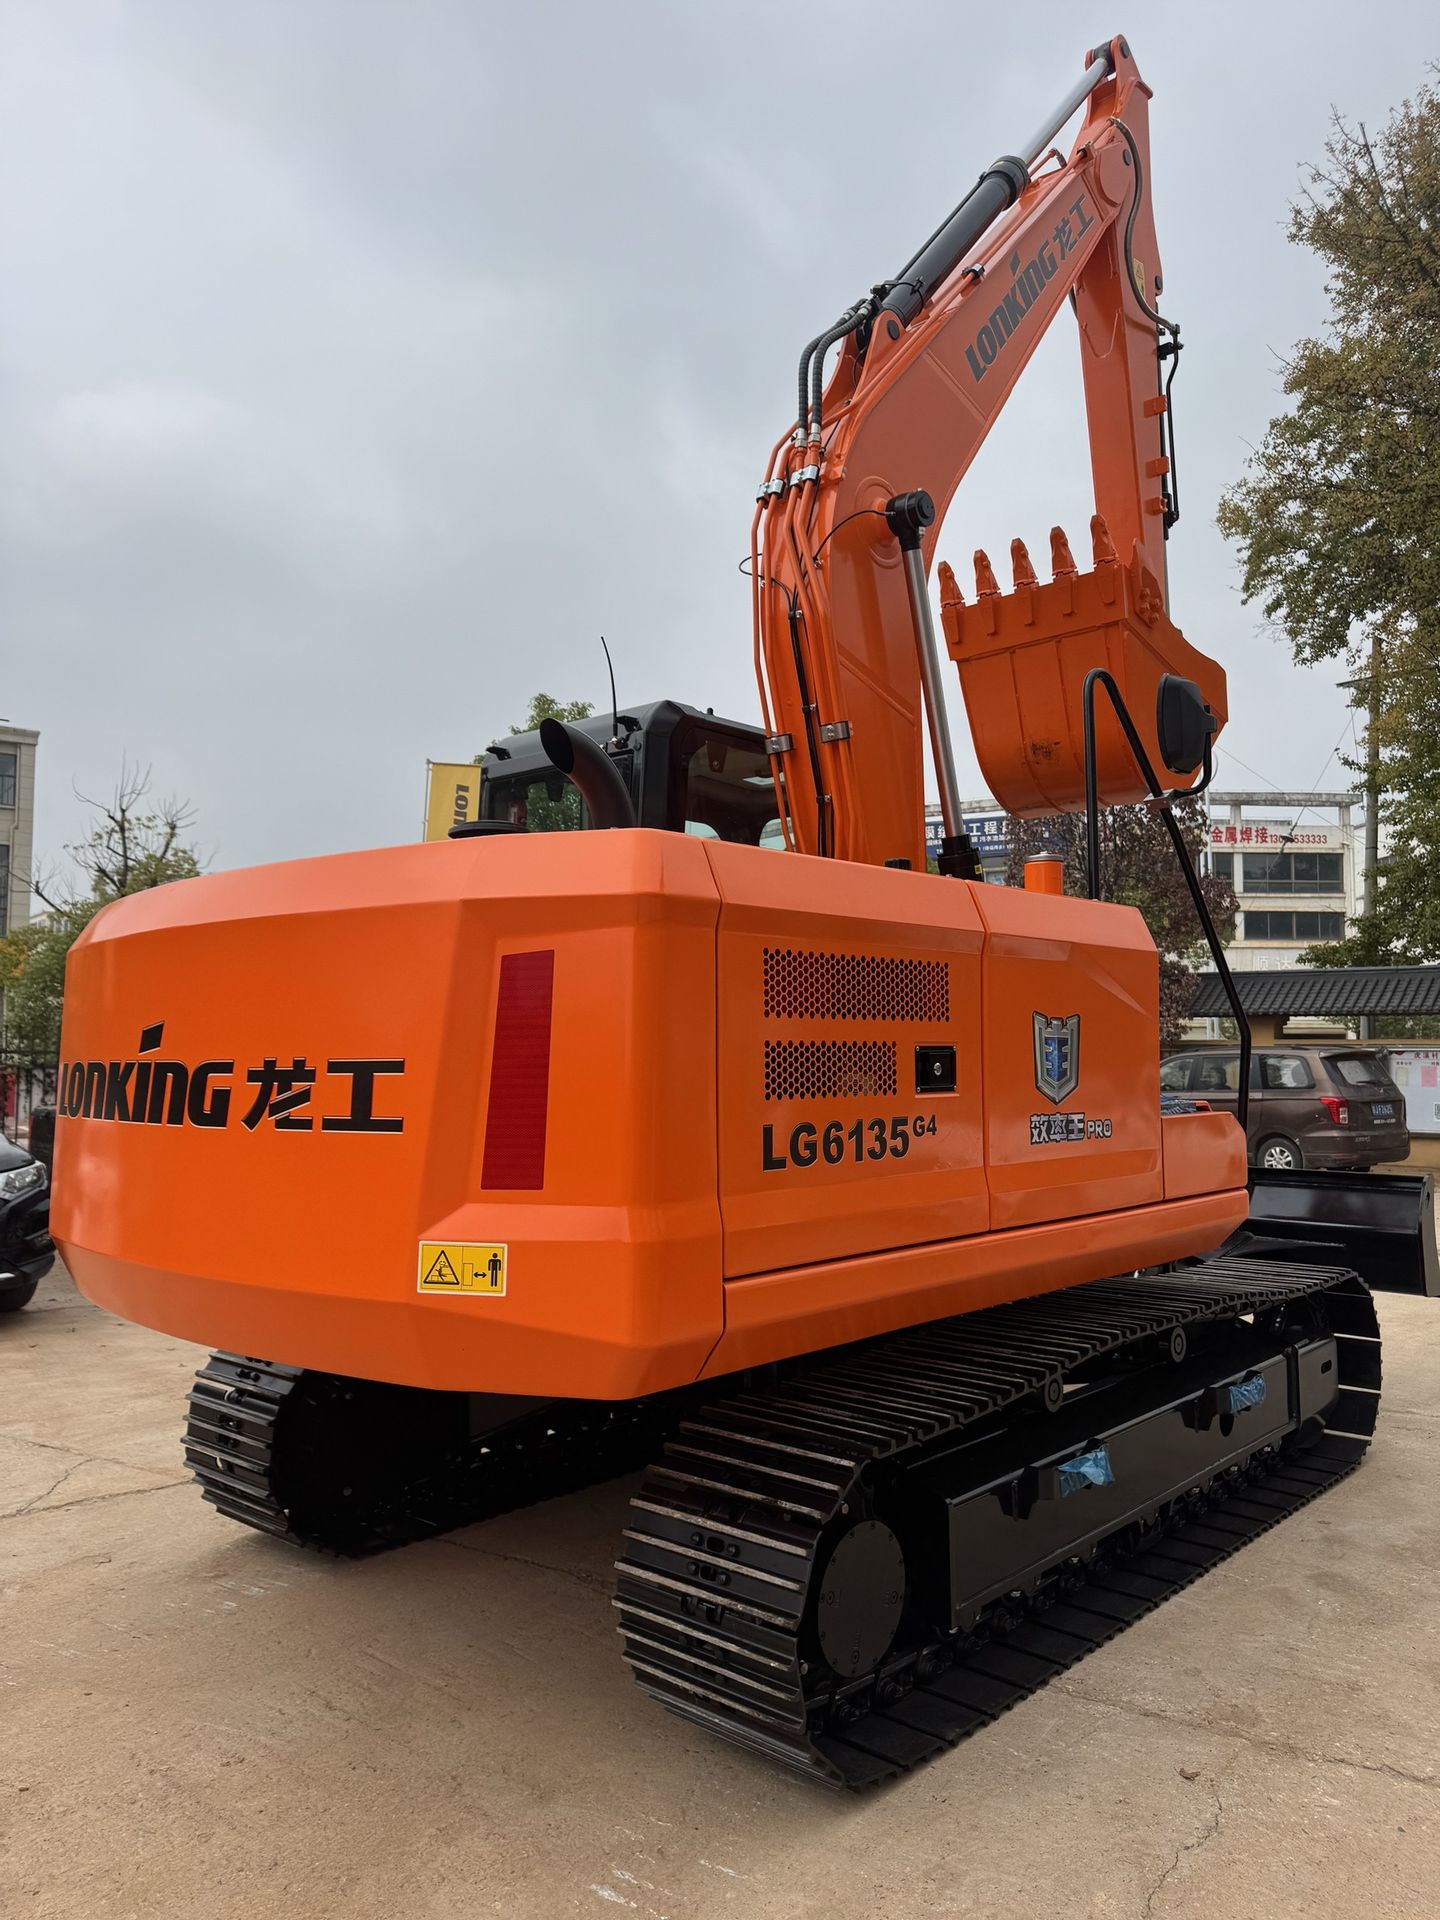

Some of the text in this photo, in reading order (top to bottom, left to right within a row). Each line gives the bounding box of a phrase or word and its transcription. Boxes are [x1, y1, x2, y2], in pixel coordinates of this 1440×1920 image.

[1053, 193, 1095, 261] 龙工
[1211, 826, 1328, 845] 金属焊接 13533333
[241, 1057, 405, 1134] 龙工
[762, 1116, 910, 1172] LG6135
[1087, 1119, 1113, 1140] PRO
